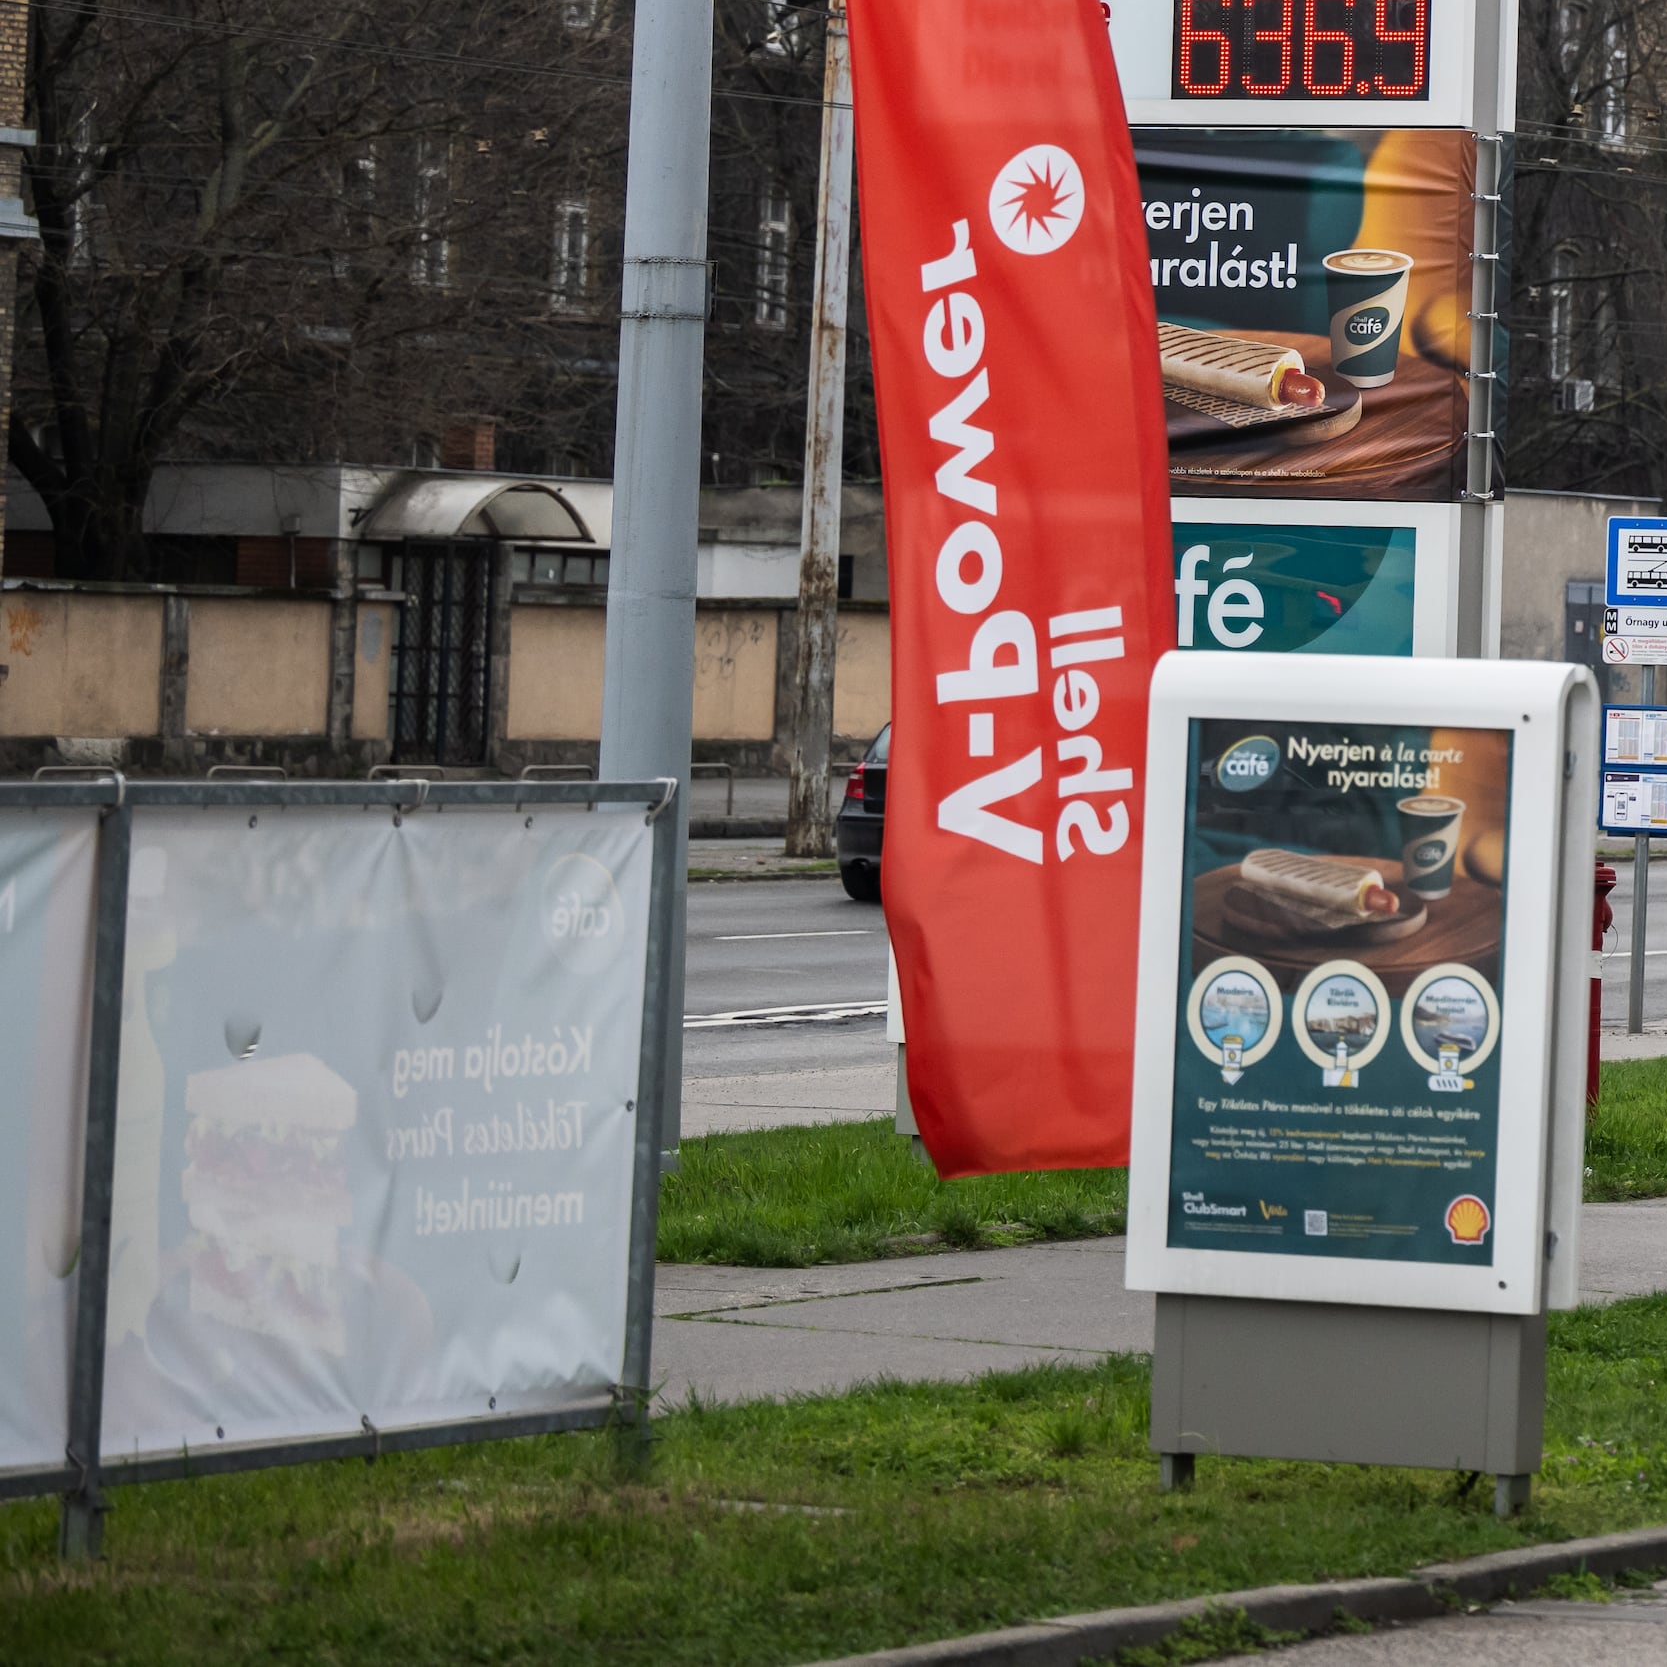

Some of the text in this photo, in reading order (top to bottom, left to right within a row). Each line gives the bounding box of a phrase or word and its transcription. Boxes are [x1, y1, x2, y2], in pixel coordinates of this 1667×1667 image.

[1141, 188, 1255, 244] erjen
[1349, 318, 1382, 335] café
[1606, 611, 1617, 621] M
[1625, 615, 1660, 629] Őrnagy
[1606, 622, 1617, 631] M
[1288, 736, 1375, 764] Nyerjen
[1397, 742, 1414, 762] la
[1419, 746, 1464, 764] carte
[1225, 753, 1269, 777] café
[1328, 766, 1440, 793] nyaralást!
[1183, 1202, 1246, 1217] ClubSmart
